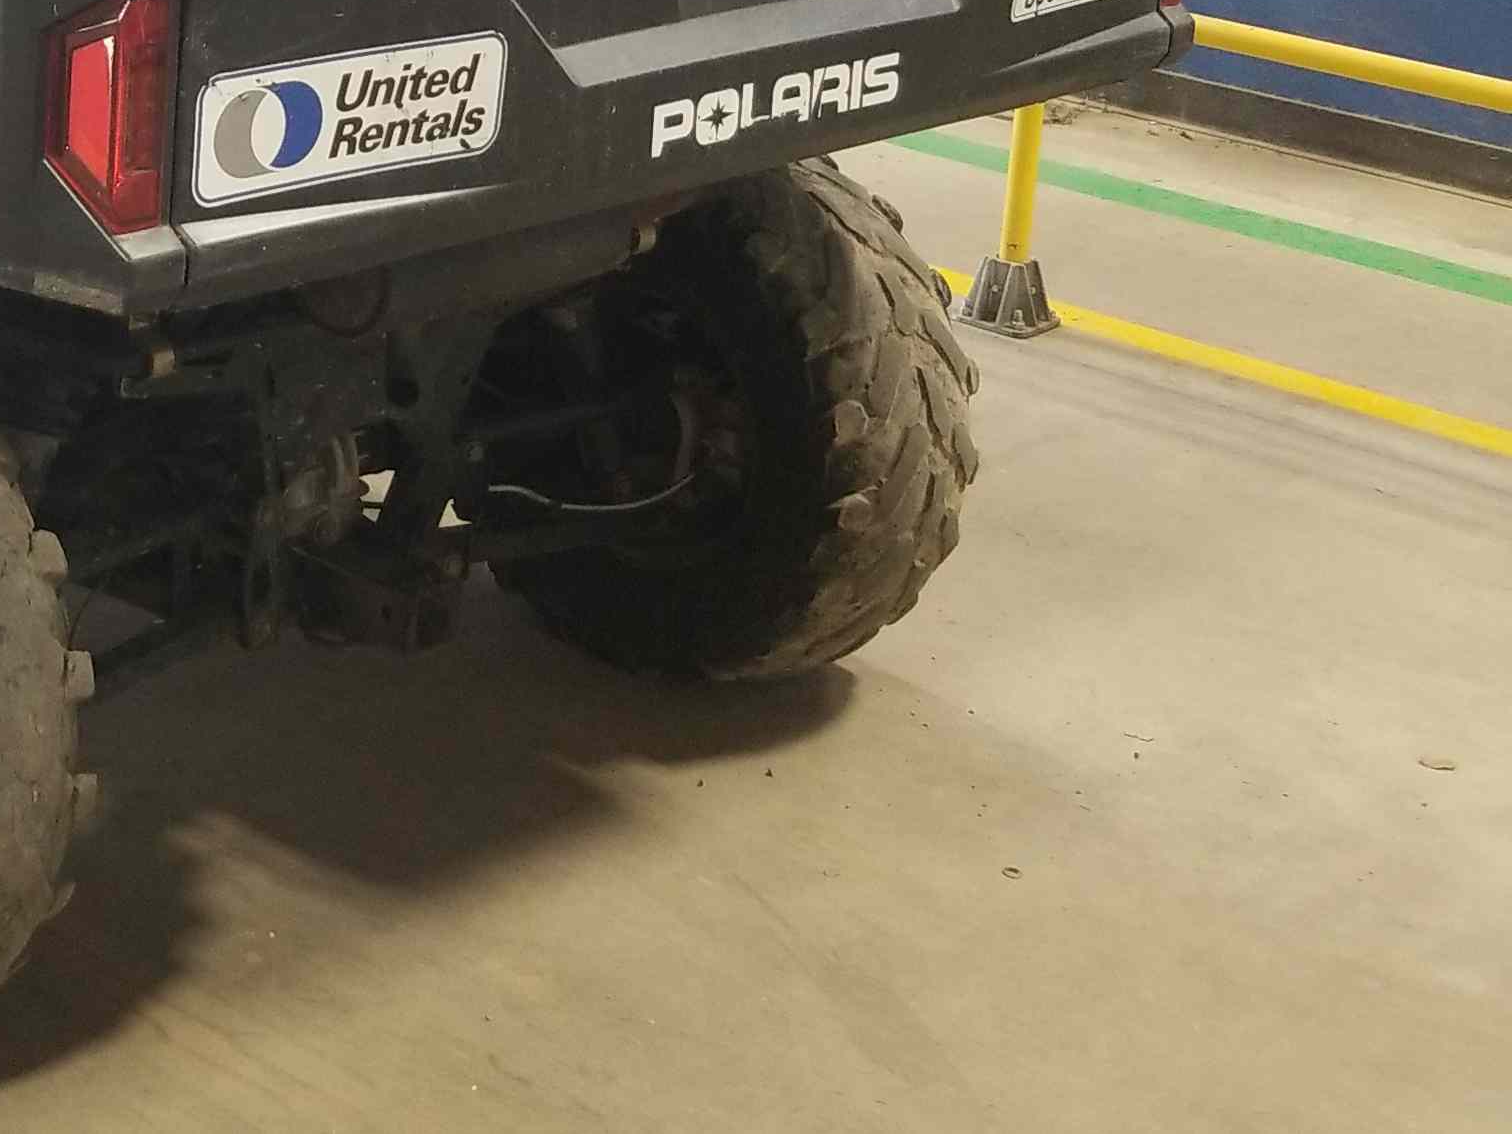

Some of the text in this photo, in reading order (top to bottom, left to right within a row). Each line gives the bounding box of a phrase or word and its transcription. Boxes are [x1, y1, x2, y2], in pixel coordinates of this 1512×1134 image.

[337, 52, 482, 112] United
[650, 51, 901, 159] POLARIS
[327, 98, 487, 159] Rentals
